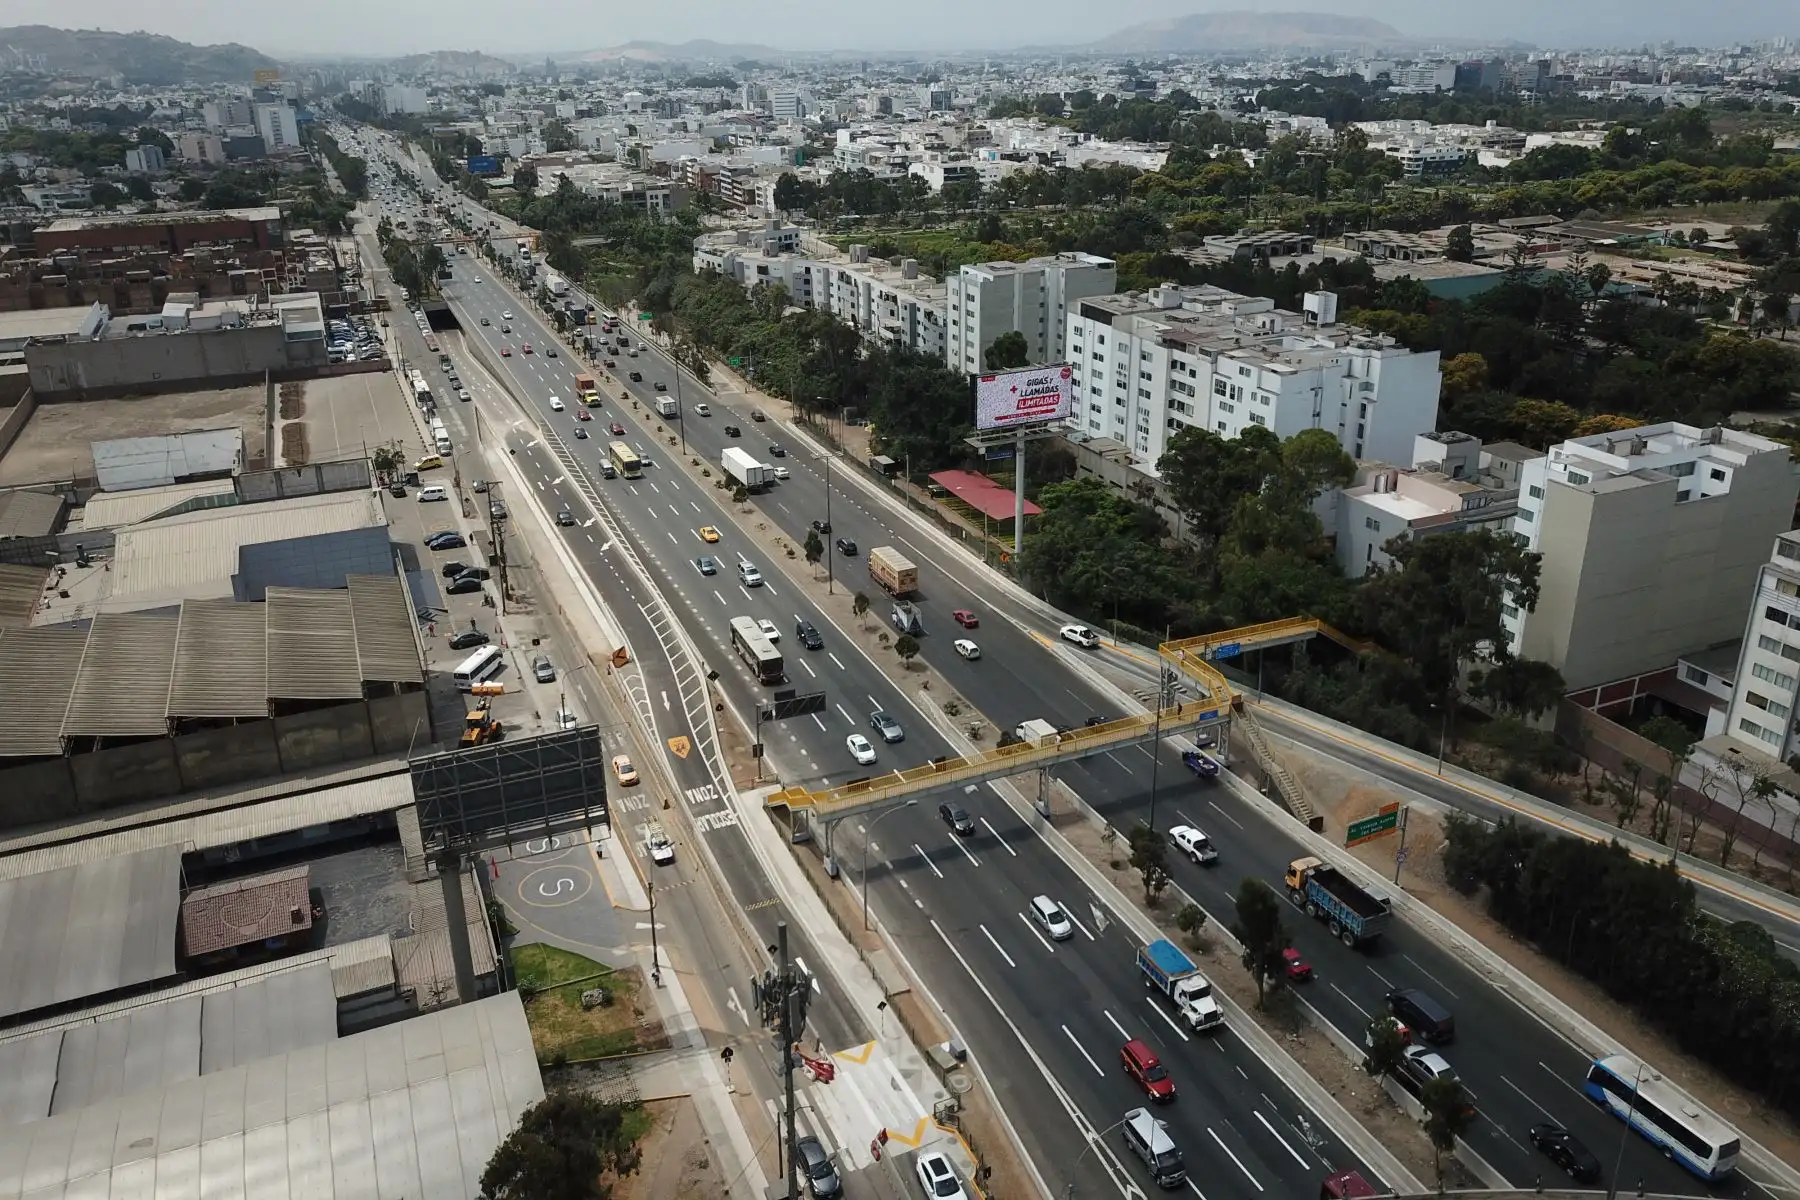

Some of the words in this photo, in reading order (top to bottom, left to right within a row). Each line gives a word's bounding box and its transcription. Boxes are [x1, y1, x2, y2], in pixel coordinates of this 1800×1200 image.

[1027, 377, 1049, 386] GIGAS
[1020, 385, 1059, 397] LLAMADAS
[1018, 396, 1059, 408] ILIMITADAS
[685, 784, 719, 804] ZONA
[617, 794, 650, 813] ZONA
